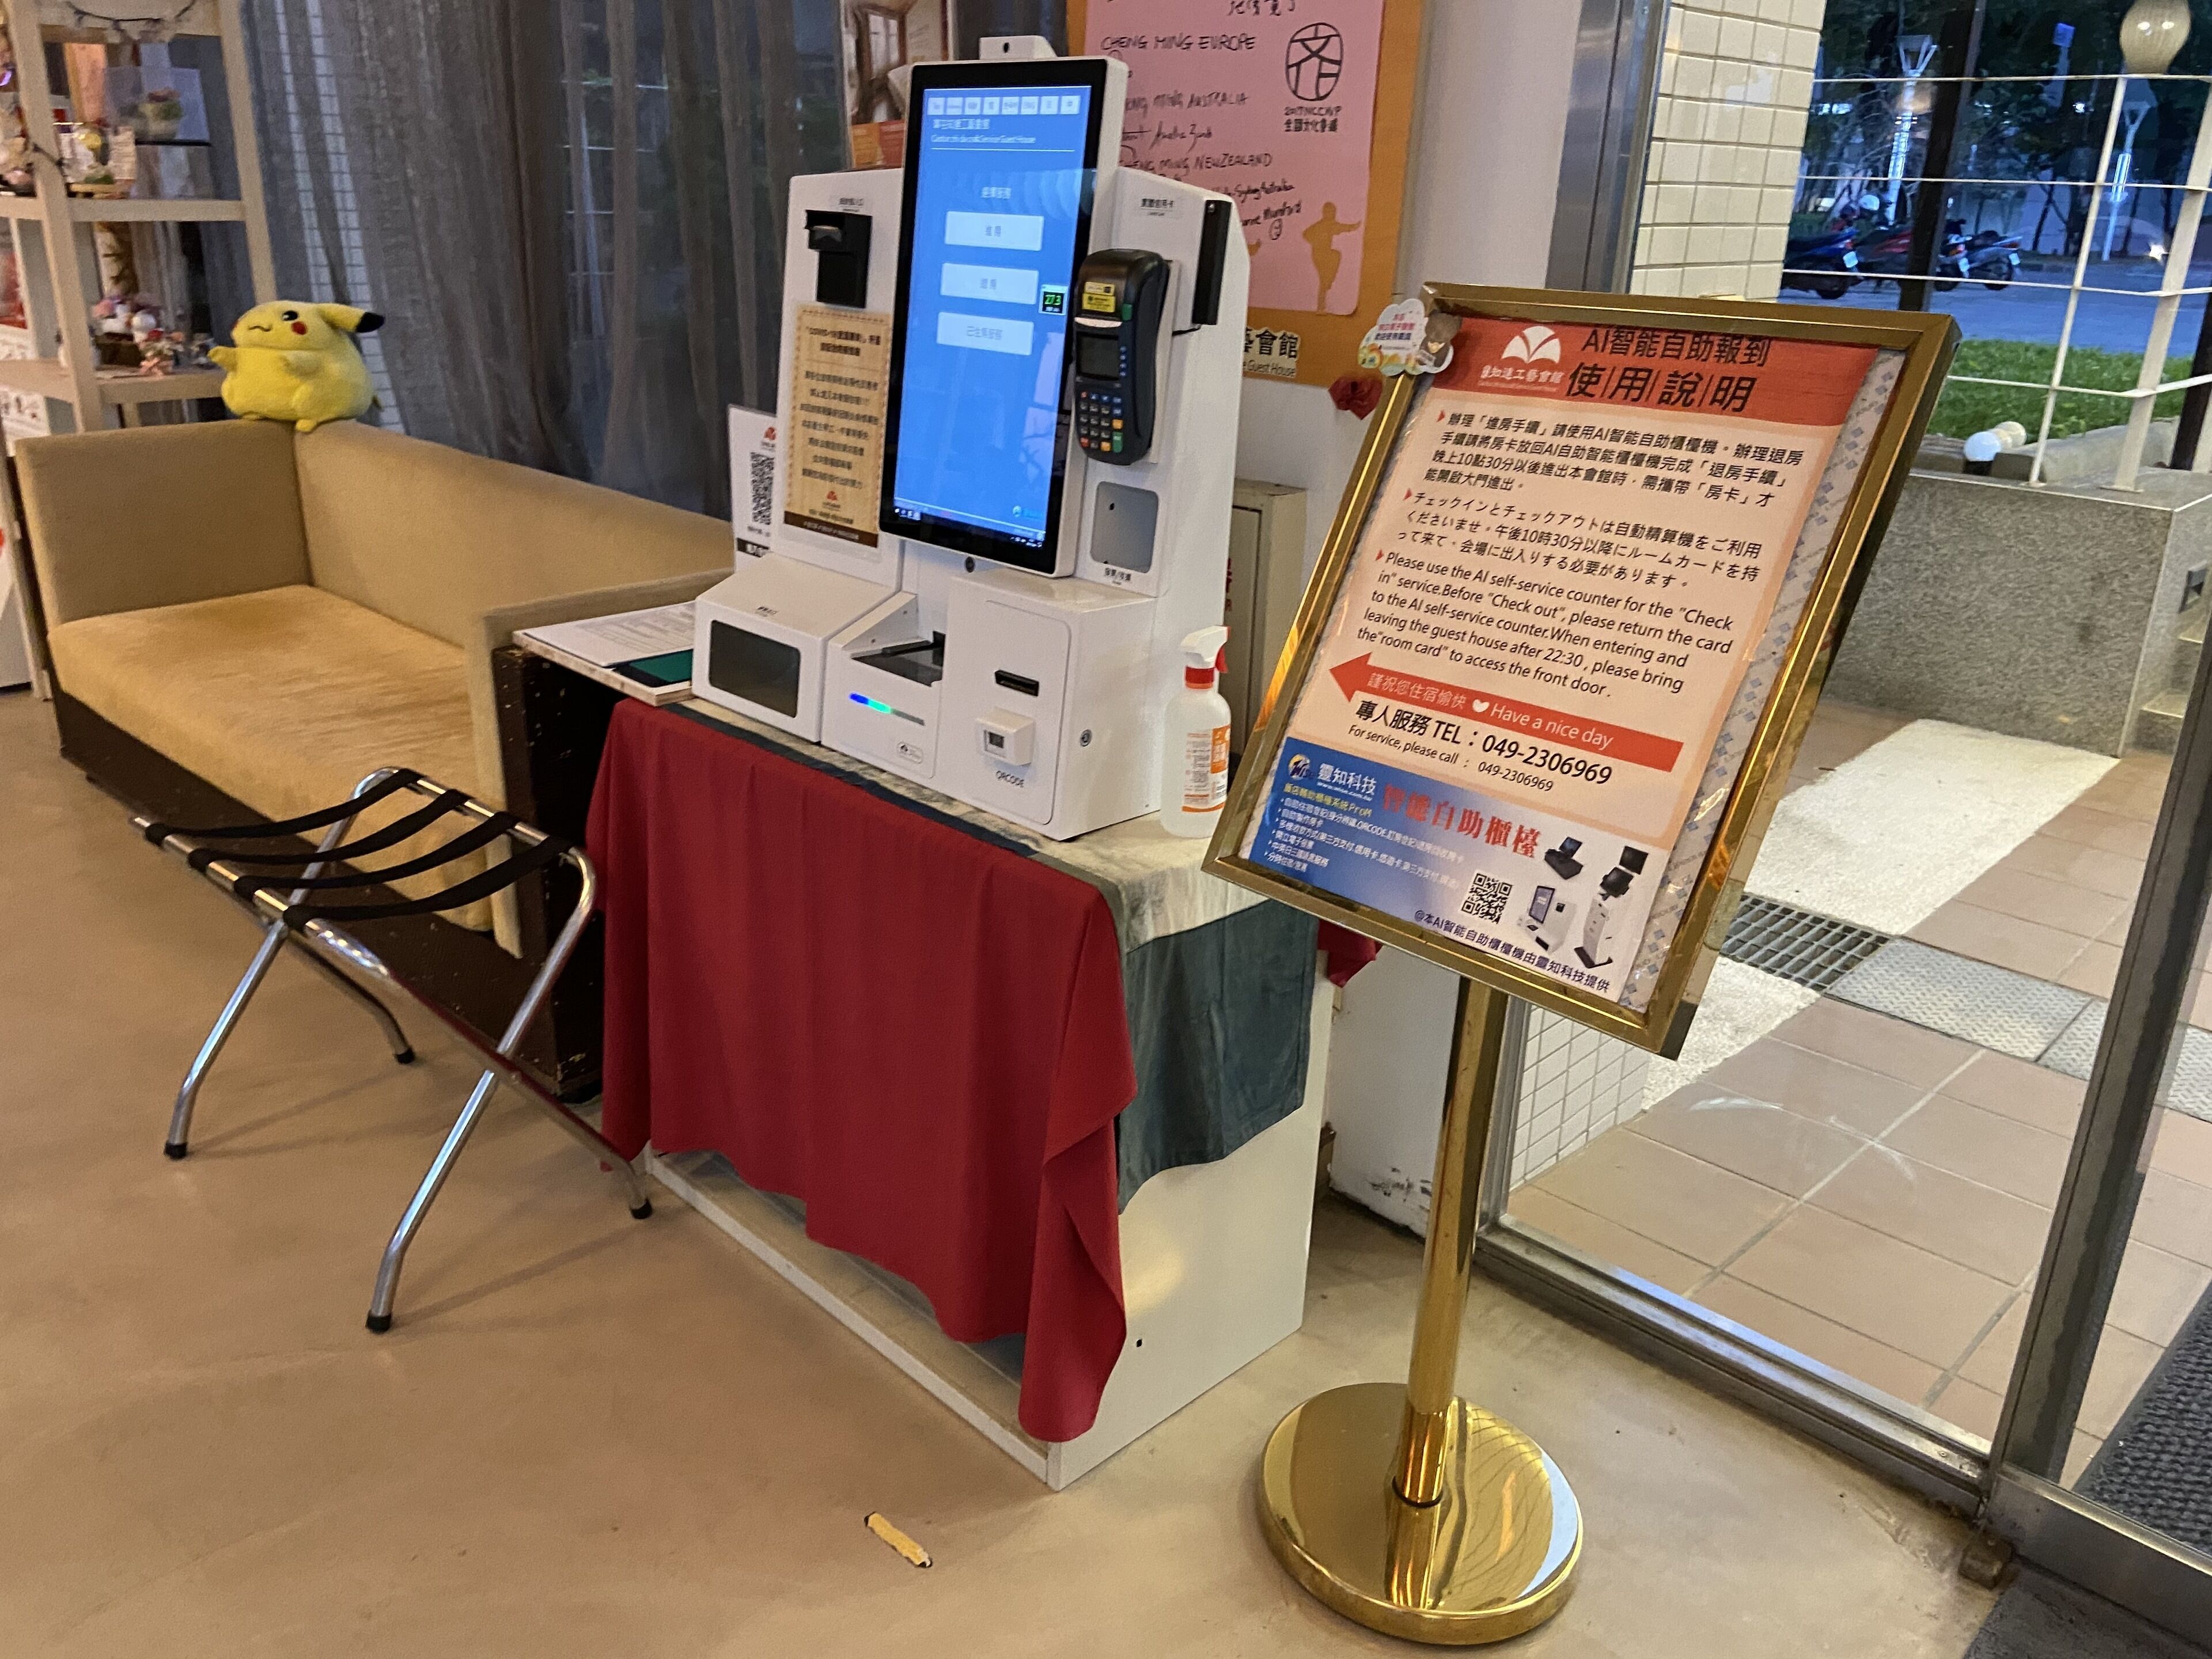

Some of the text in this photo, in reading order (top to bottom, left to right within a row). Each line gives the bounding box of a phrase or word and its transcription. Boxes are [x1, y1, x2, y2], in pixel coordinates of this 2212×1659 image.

[1153, 33, 1194, 50] MING
[1198, 33, 1256, 50] EUROPE
[1580, 326, 1774, 367] AI智能自助報到
[1386, 552, 1424, 570] Please
[1427, 563, 1448, 575] use
[1452, 566, 1471, 579] the
[1472, 570, 1489, 582] AI
[1490, 575, 1563, 597] self-service
[1567, 590, 1622, 608] counter
[1624, 597, 1645, 612] for
[1649, 602, 1673, 618] the
[1397, 578, 1482, 603] service.Before
[1569, 611, 1615, 629] please
[1618, 623, 1662, 638] return
[1668, 629, 1692, 645] the
[1696, 639, 1733, 653] card
[1364, 608, 1407, 631] leaving
[1410, 619, 1429, 633] the
[1430, 627, 1467, 641] guest
[1468, 631, 1508, 650] house
[1510, 642, 1543, 657] after
[1543, 648, 1583, 666] 22:30
[1591, 660, 1638, 679] please
[1642, 669, 1684, 694] bring
[1372, 590, 1688, 667] to the AI self-service counter.When entering and
[1450, 650, 1463, 661] to
[1465, 656, 1506, 671] access
[1509, 662, 1530, 677] the
[1533, 667, 1568, 686] front
[1571, 677, 1606, 694] door
[1356, 701, 1431, 736] 專人服務
[1483, 735, 1611, 784] 049-2306969
[1366, 671, 1613, 750] 謹祝您住宿愉快 Have a nice day
[1349, 725, 1366, 737] For
[1366, 732, 1401, 749] service,
[1403, 742, 1437, 758] please
[1440, 753, 1459, 763] call
[1479, 762, 1552, 791] 049-2306969
